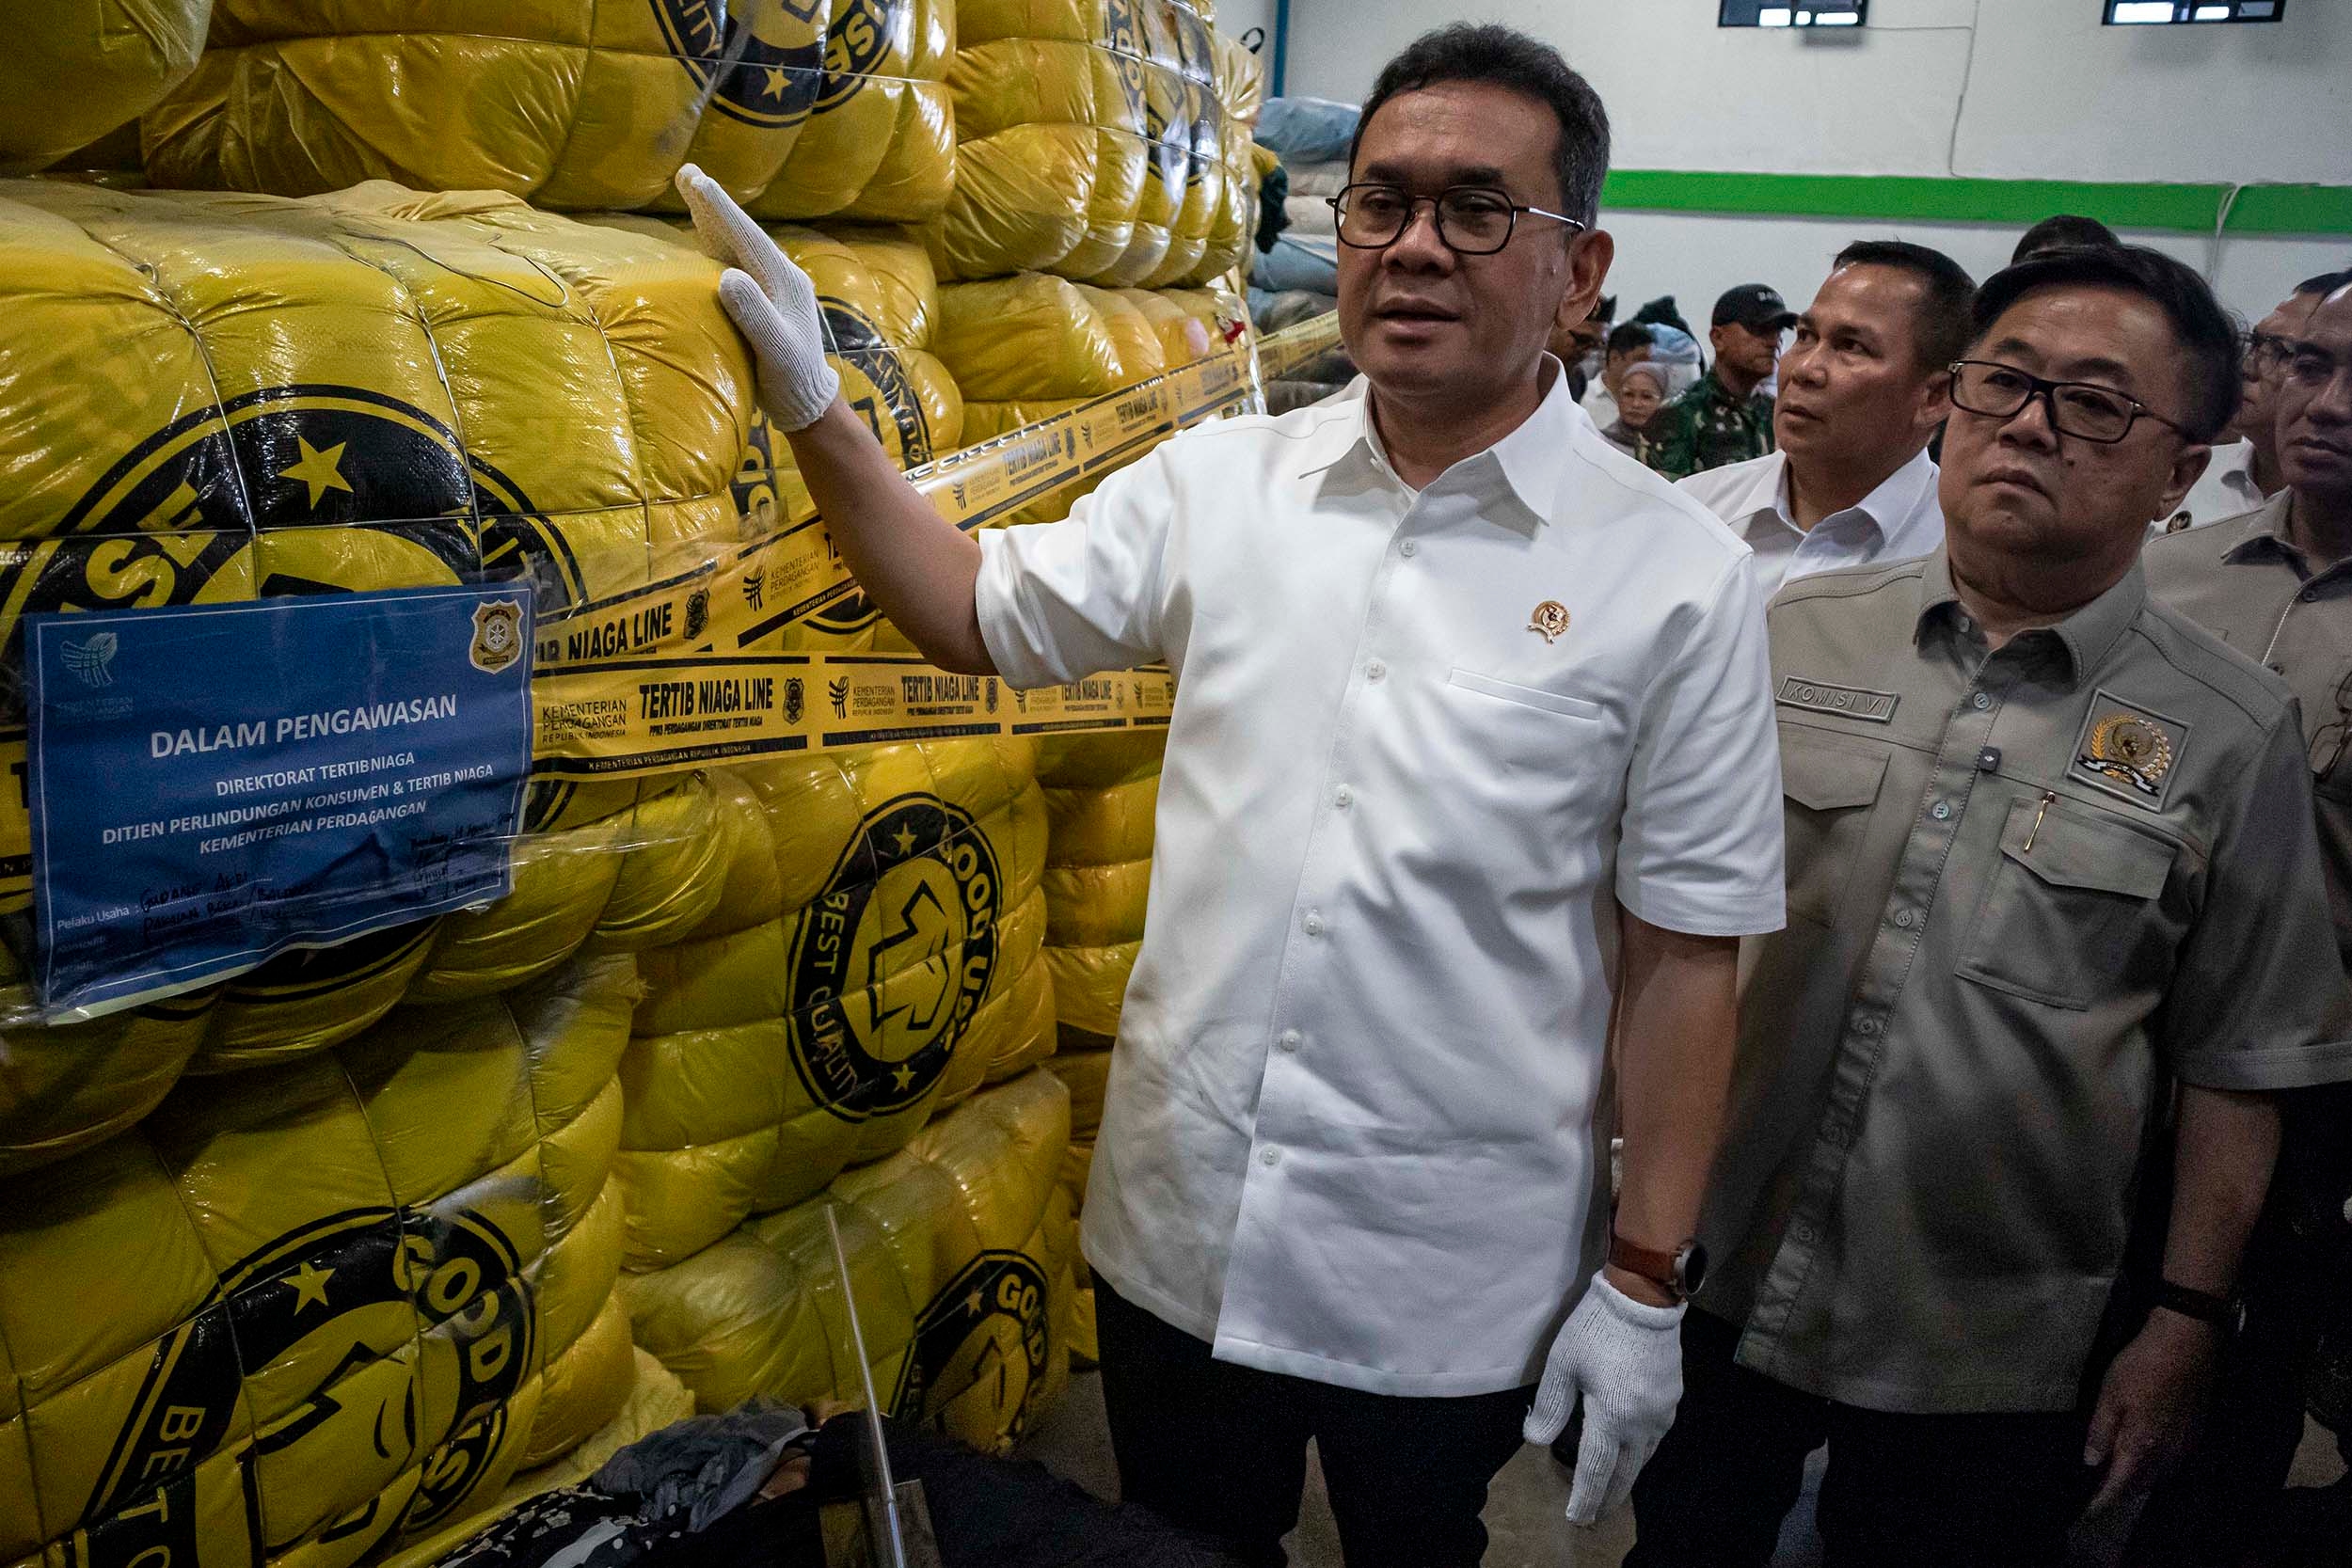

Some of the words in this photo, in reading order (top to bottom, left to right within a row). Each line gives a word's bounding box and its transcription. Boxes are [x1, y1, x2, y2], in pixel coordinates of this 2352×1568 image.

[568, 618, 628, 660] NIAGA
[634, 601, 672, 647] LINE
[639, 681, 695, 719] TERTIB
[698, 679, 739, 714] NIAGA
[744, 677, 773, 712] LINE
[901, 675, 932, 703] TERTIB
[934, 675, 961, 703] NIAGA
[961, 675, 979, 702] LINE
[1788, 683, 1858, 710] KOMISI
[1866, 695, 1887, 716] VI
[151, 719, 266, 759] DALAM
[276, 693, 458, 744] PENGAWASAN
[542, 699, 627, 721] KEMENTERIAN
[215, 767, 315, 797] DIREKTORAT
[588, 757, 643, 771] KEMENTERIAN
[102, 814, 165, 845] DITJEN
[169, 799, 302, 833] PERLINDUNGAN
[305, 784, 389, 812] KONSUMEN
[392, 783, 405, 798] &
[407, 773, 452, 794] TERTIB
[454, 764, 494, 784] NIAGA
[199, 817, 312, 854] KEMENTERIAN
[316, 800, 427, 832] PERDAGANGAN
[56, 913, 94, 931] Pelaku
[95, 906, 130, 923] Usaha
[814, 893, 850, 975] BEST
